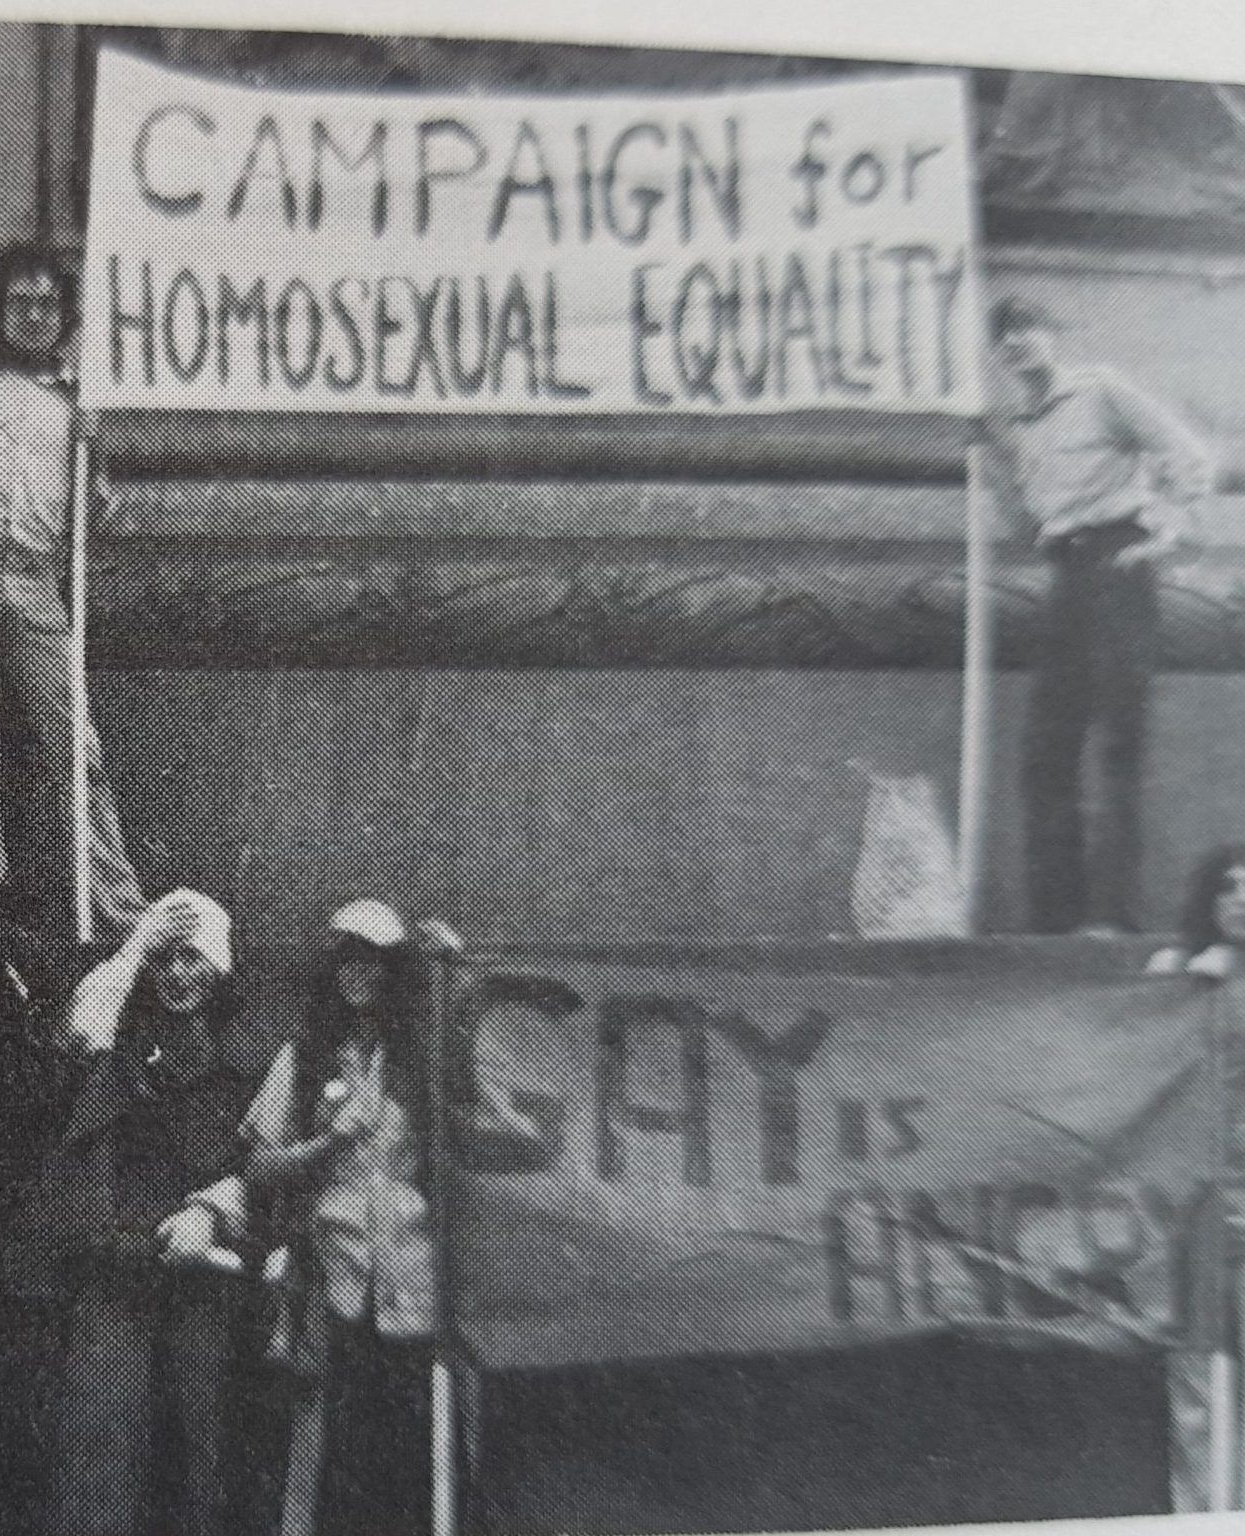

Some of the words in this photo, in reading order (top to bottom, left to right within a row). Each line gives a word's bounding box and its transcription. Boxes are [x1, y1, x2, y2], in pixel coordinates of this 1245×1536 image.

[132, 104, 743, 244] CAMPAIGN
[790, 118, 948, 230] for
[108, 254, 592, 398] HOMOSEXUAL
[630, 242, 967, 403] EQUALITY
[446, 973, 836, 1188] GAY
